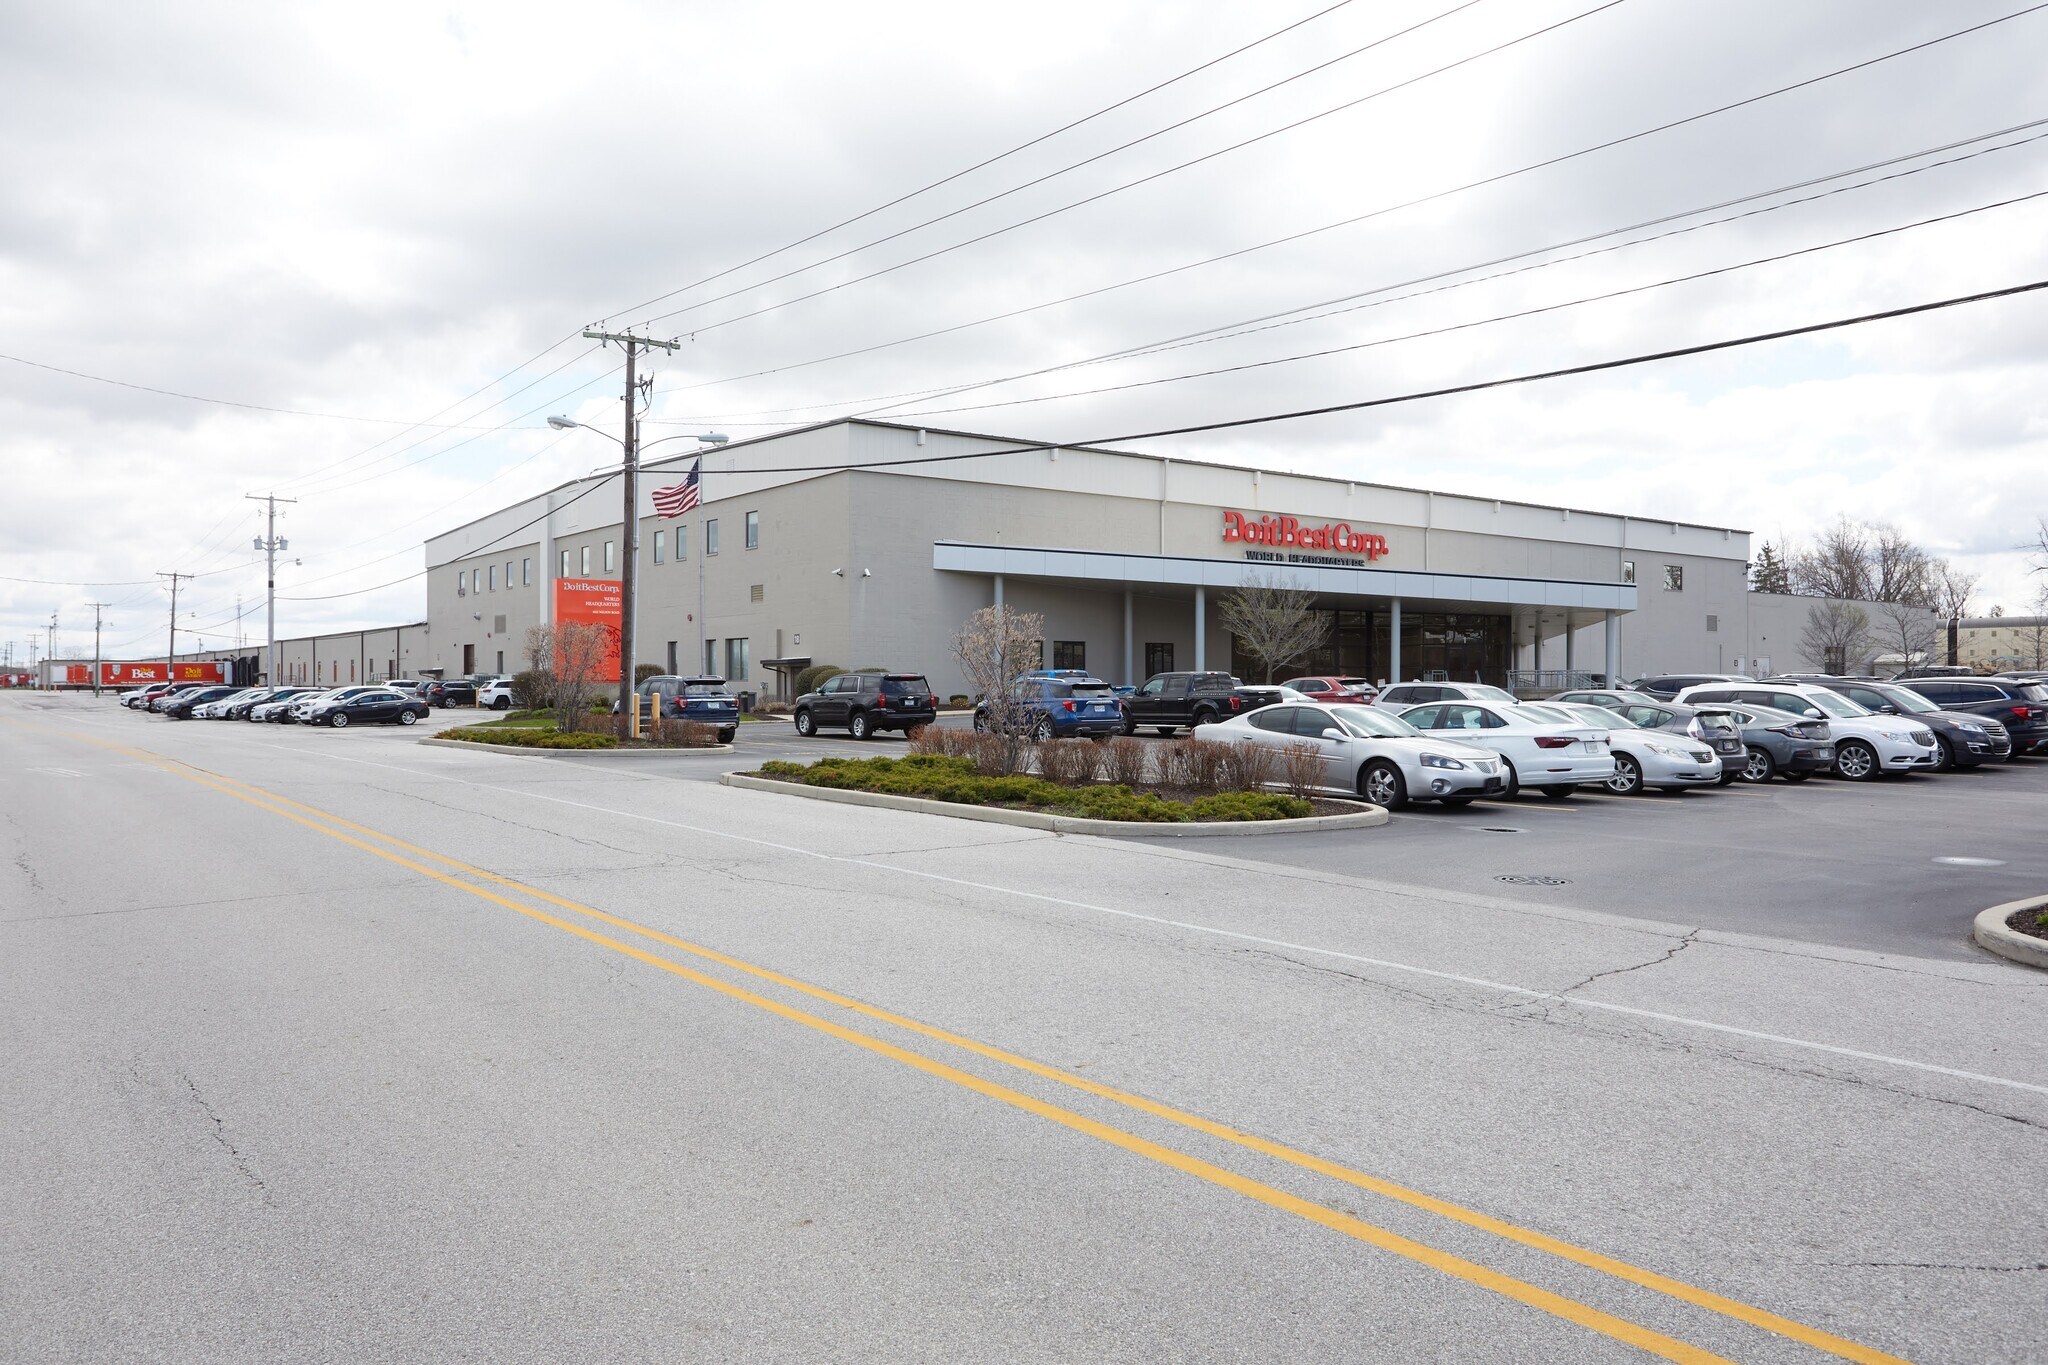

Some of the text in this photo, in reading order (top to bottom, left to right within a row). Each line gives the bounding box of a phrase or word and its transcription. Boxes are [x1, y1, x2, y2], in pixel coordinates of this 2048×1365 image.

[1246, 551, 1365, 567] WORLD HEADQUARTERS
[132, 668, 156, 678] Best
